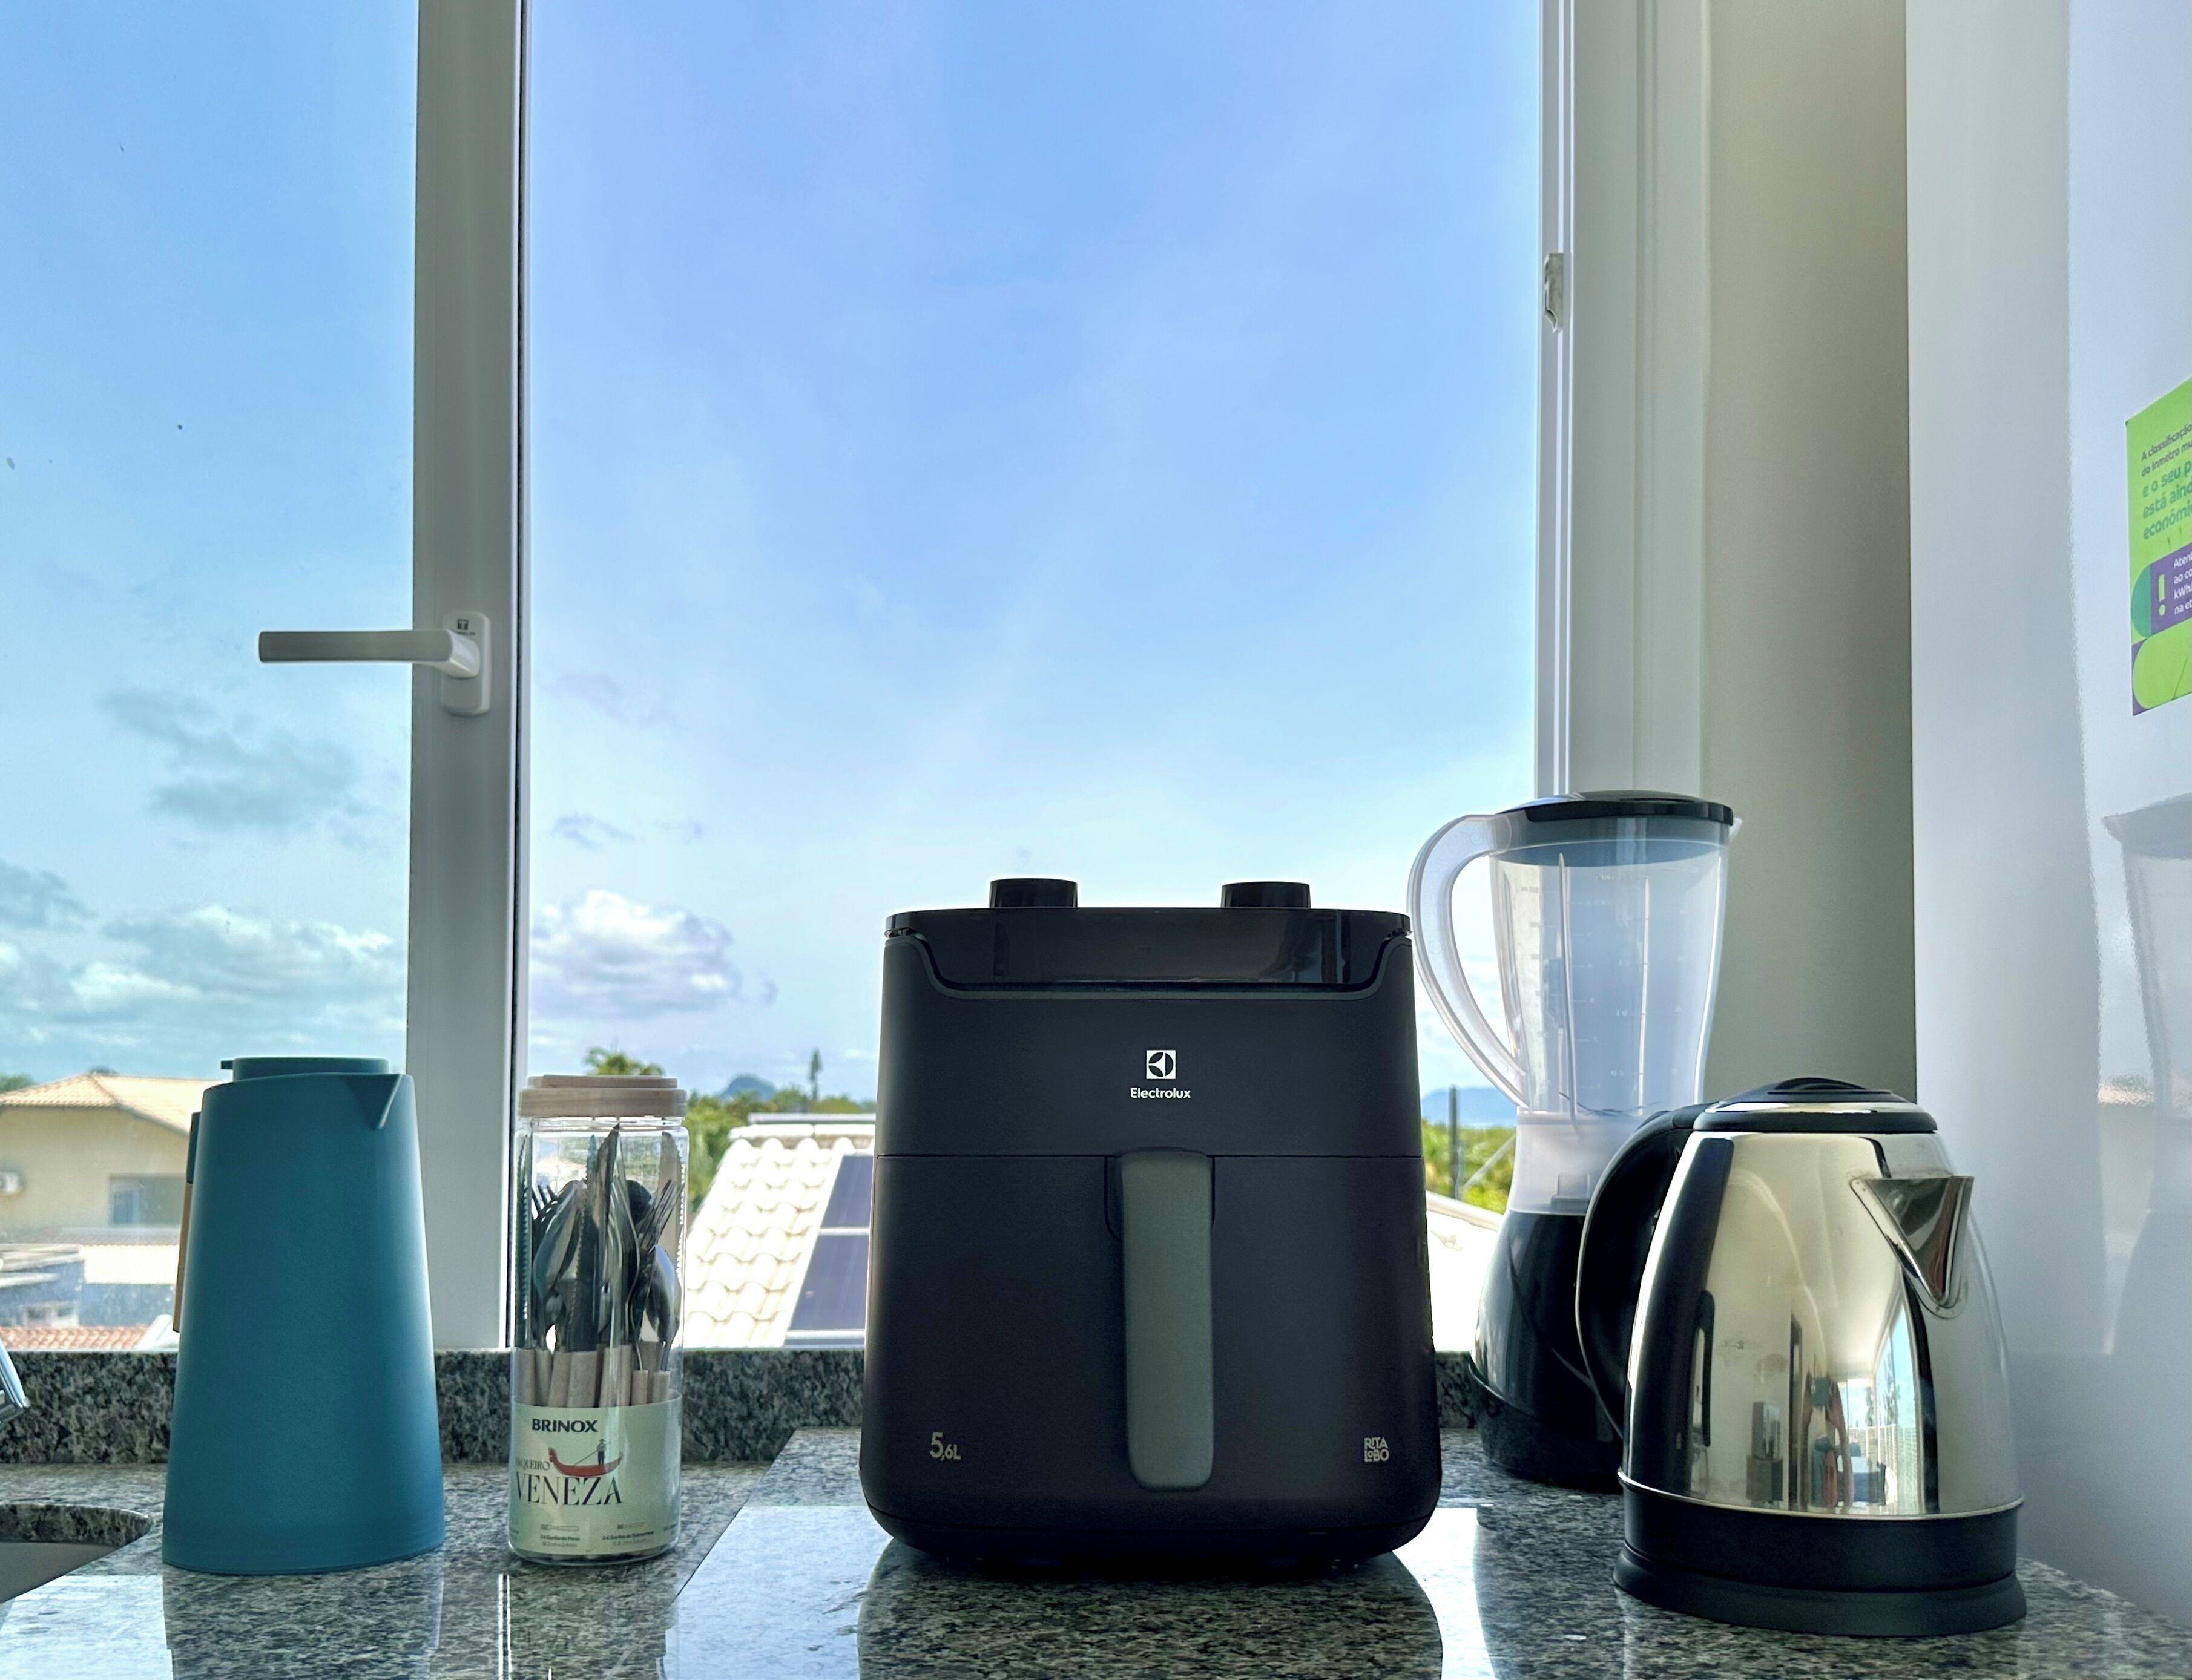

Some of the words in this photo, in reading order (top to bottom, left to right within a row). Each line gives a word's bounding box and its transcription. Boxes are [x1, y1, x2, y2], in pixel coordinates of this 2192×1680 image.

[2141, 451, 2147, 462] A
[2148, 424, 2192, 457] classificação
[2141, 465, 2151, 477] do
[2151, 448, 2180, 471] Inmetro
[2142, 485, 2148, 497] e
[2151, 480, 2158, 492] o
[2161, 465, 2181, 487] seu
[2184, 460, 2191, 477] p
[2142, 491, 2167, 519] está
[2174, 574, 2183, 584] ao
[2174, 604, 2184, 615] na
[1130, 1087, 1191, 1098] Electrolux
[532, 1418, 599, 1433] BRINOX
[1364, 1436, 1389, 1449] RITA
[516, 1471, 623, 1506] VENEZA
